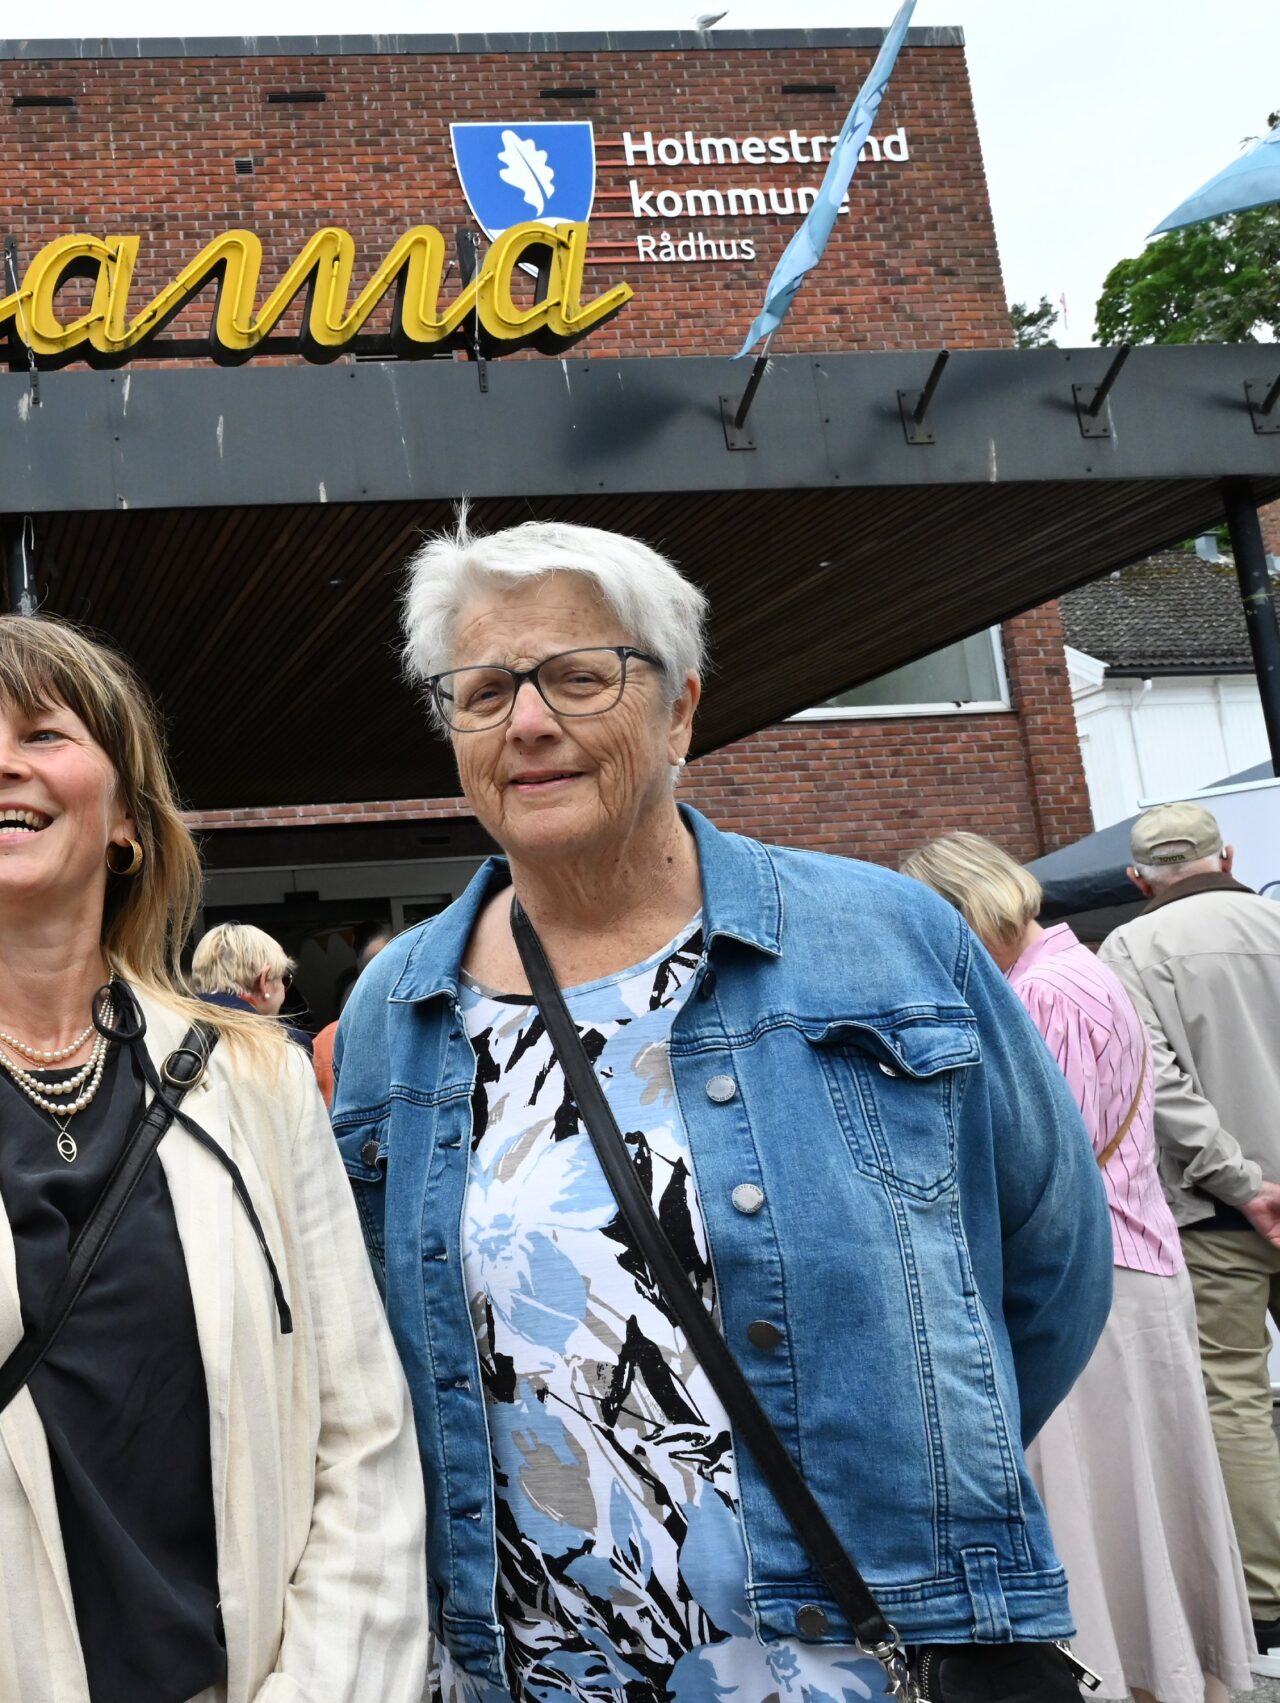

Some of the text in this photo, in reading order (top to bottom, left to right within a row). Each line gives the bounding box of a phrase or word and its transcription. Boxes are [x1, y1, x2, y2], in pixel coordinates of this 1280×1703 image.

[629, 180, 850, 218] kommun
[636, 231, 756, 262] Rådhus
[1159, 854, 1186, 863] TOYOTA
